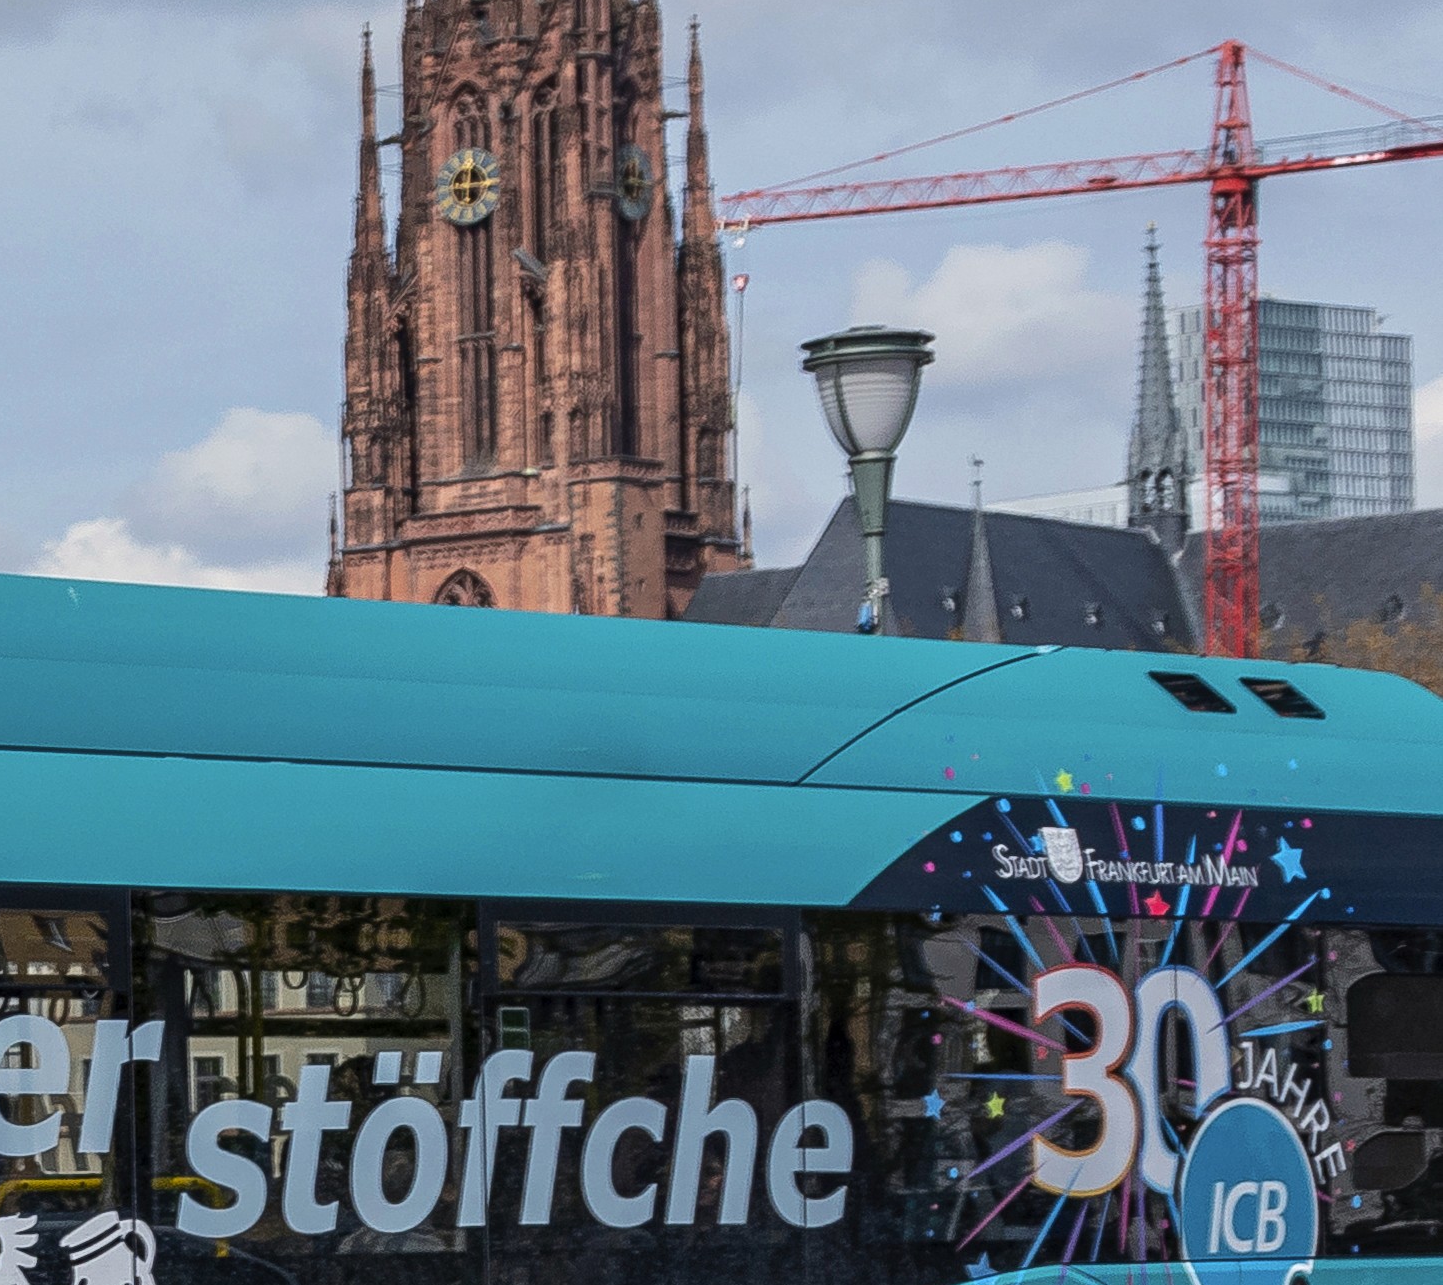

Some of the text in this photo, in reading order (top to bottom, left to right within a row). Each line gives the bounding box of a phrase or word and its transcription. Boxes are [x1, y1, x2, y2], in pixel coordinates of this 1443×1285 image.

[176, 1047, 856, 1239] stöffche
[1031, 961, 1232, 1197] 30
[1235, 1041, 1347, 1185] JAHRE
[1208, 1179, 1289, 1254] ICB
